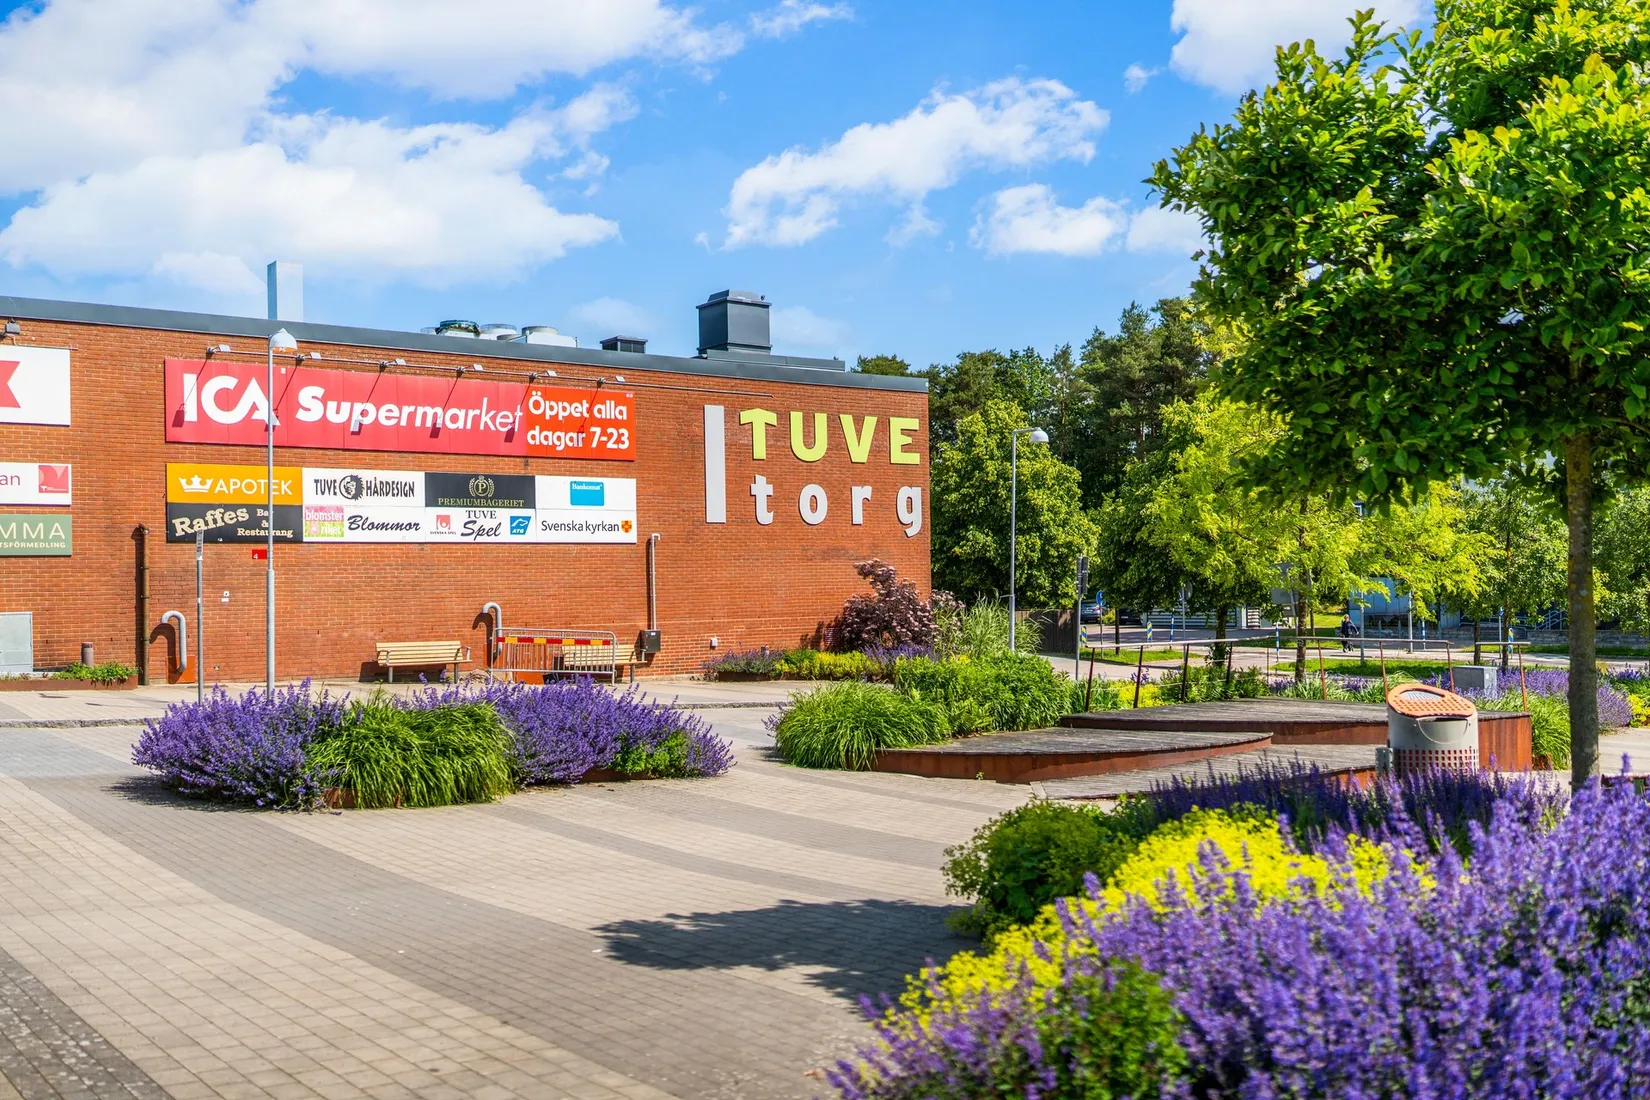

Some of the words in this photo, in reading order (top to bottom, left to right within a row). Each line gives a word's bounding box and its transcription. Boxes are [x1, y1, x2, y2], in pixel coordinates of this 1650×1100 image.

[183, 373, 281, 426] ICA
[295, 385, 523, 432] Supermarket
[528, 390, 589, 421] Öppet
[593, 400, 627, 420] alla
[526, 425, 585, 451] dagar
[589, 426, 630, 450] 7-23
[739, 408, 921, 465] TUVE
[214, 478, 293, 496] APOTEK
[314, 478, 337, 496] TUVE
[366, 476, 415, 498] HÅRDESIGN
[256, 508, 274, 517] Ba
[438, 497, 525, 507] PREMIUMBAGERIET
[750, 473, 923, 538] torg
[172, 507, 250, 537] Raffes
[305, 510, 343, 521] blomster
[347, 514, 421, 531] Blommor
[465, 509, 497, 520] TUVE
[460, 519, 502, 541] Spel
[541, 520, 583, 532] Svenska
[585, 520, 620, 535] kyrkan
